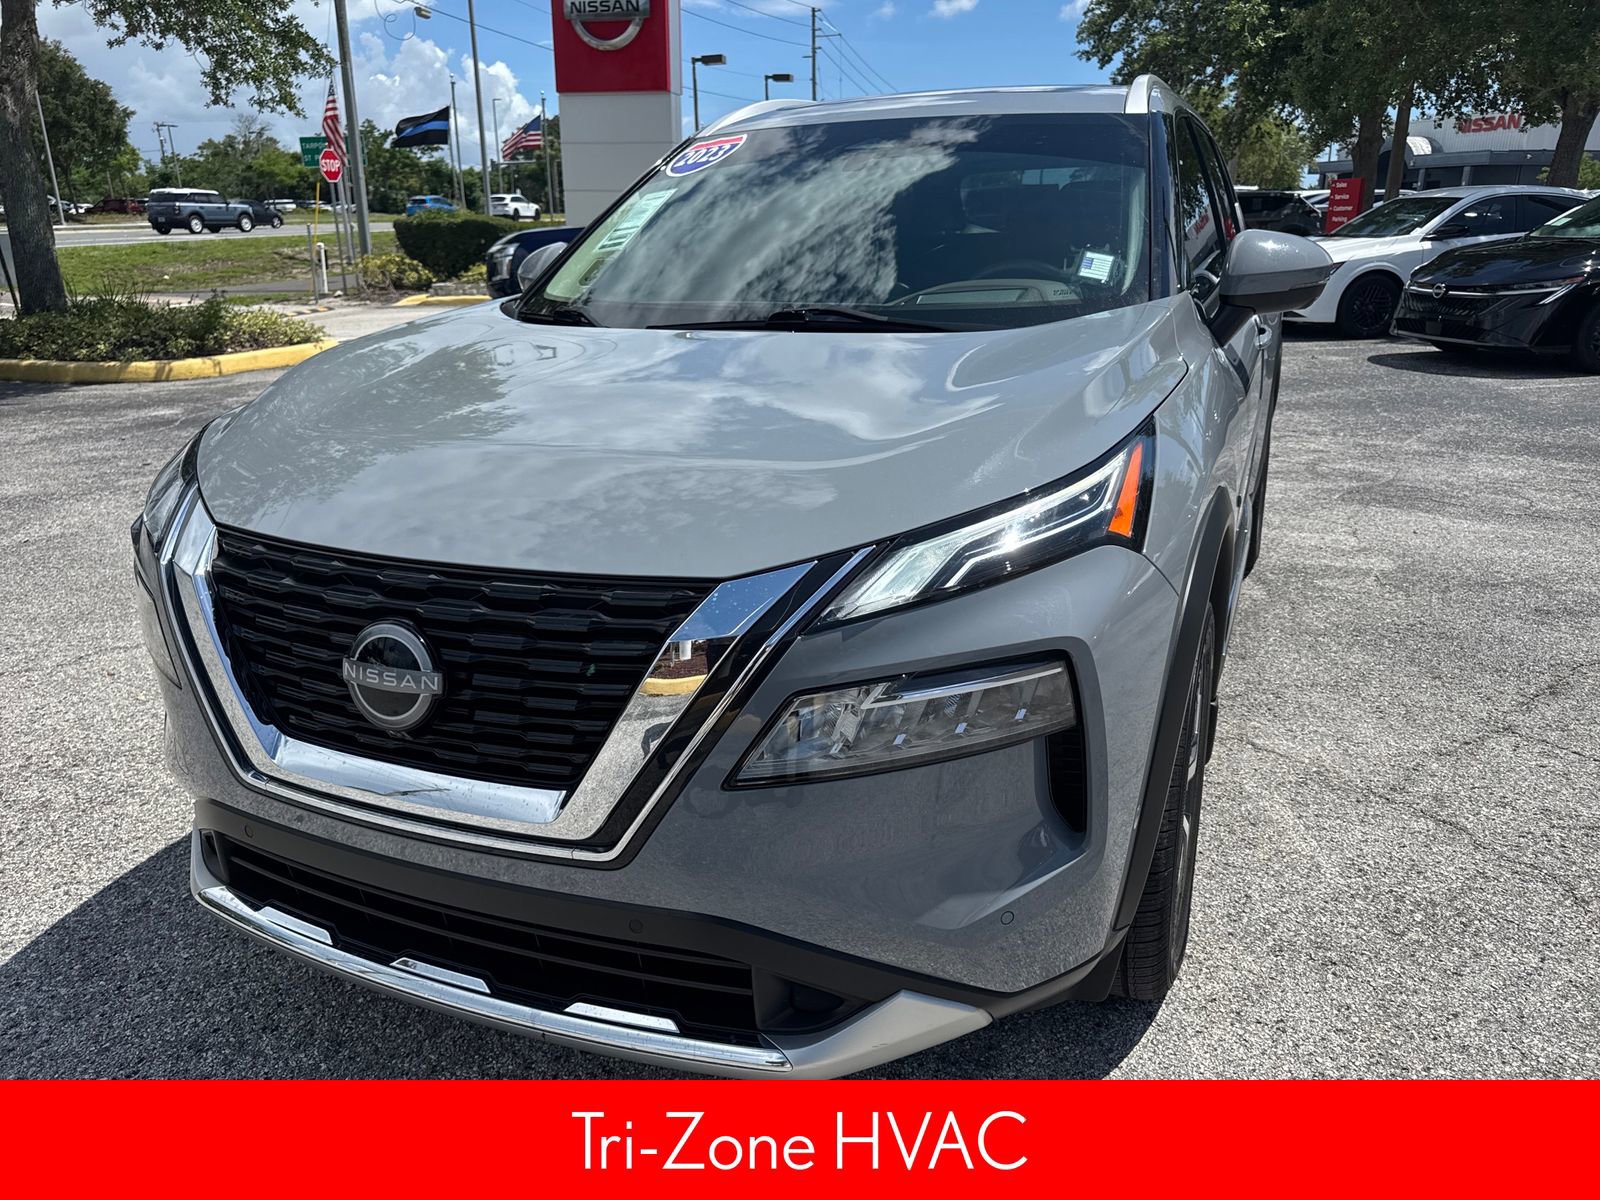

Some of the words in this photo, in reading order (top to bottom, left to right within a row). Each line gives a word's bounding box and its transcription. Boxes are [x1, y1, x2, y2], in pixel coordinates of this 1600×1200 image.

[570, 0, 640, 14] NISSAN
[1457, 112, 1522, 134] NISSAN
[321, 158, 341, 172] STOP
[673, 144, 731, 168] 2023
[343, 661, 439, 691] NISSAN
